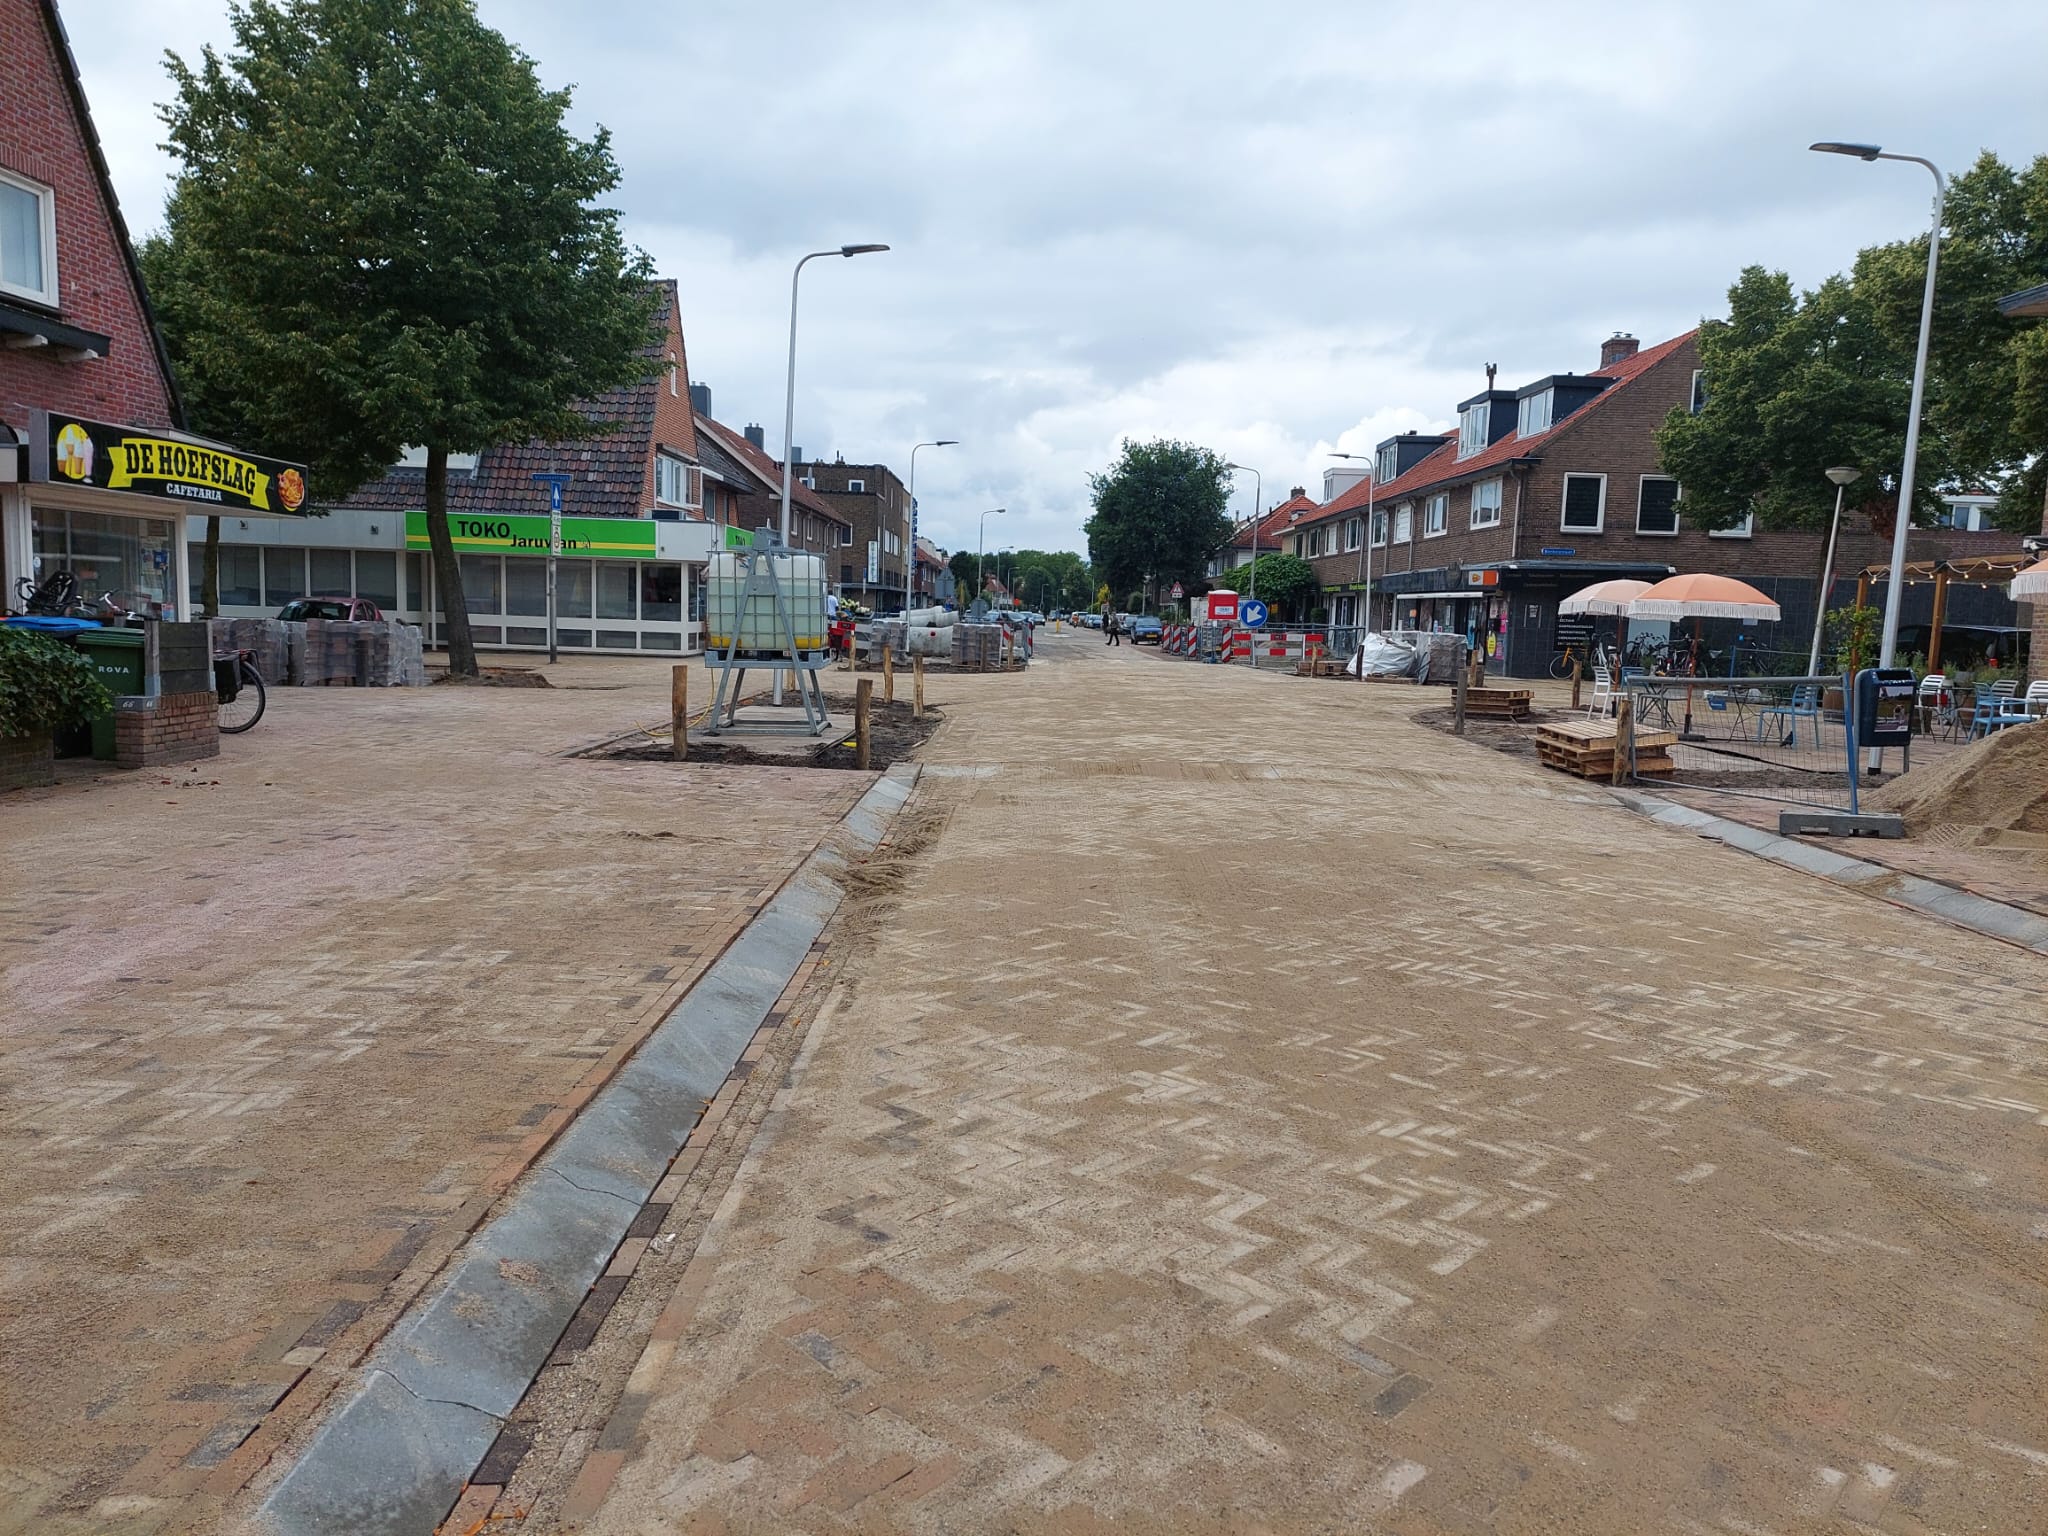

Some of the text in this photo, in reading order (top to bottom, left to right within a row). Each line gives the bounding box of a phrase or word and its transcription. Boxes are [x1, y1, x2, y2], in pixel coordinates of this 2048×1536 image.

[123, 442, 257, 496] DE HOEFSLAG
[166, 483, 222, 501] CAFETARIA
[457, 520, 511, 539] TOKO
[98, 666, 129, 674] ROVA
